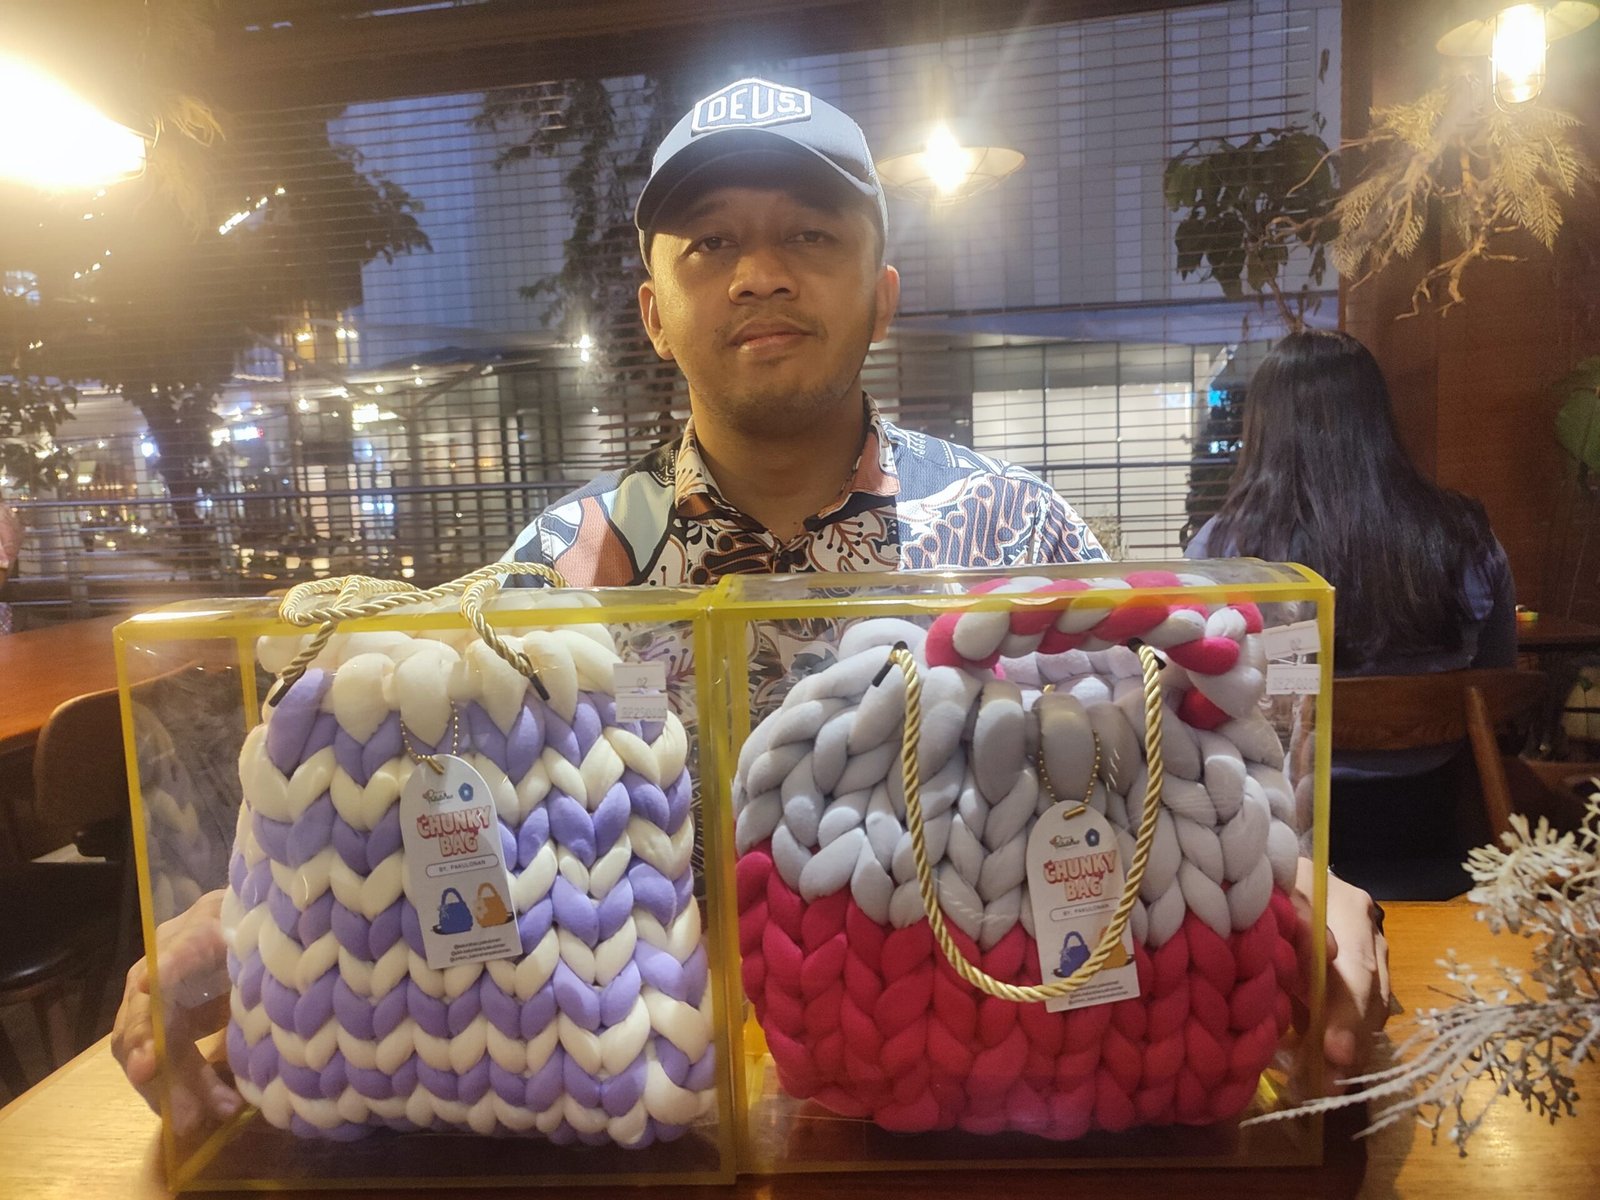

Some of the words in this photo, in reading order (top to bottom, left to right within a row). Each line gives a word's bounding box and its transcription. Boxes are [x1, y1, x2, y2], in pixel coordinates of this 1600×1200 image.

[416, 805, 491, 839] CHUNKY
[439, 829, 479, 857] BAG
[1043, 850, 1117, 884] CHUNKY
[1065, 876, 1103, 901] BAG
